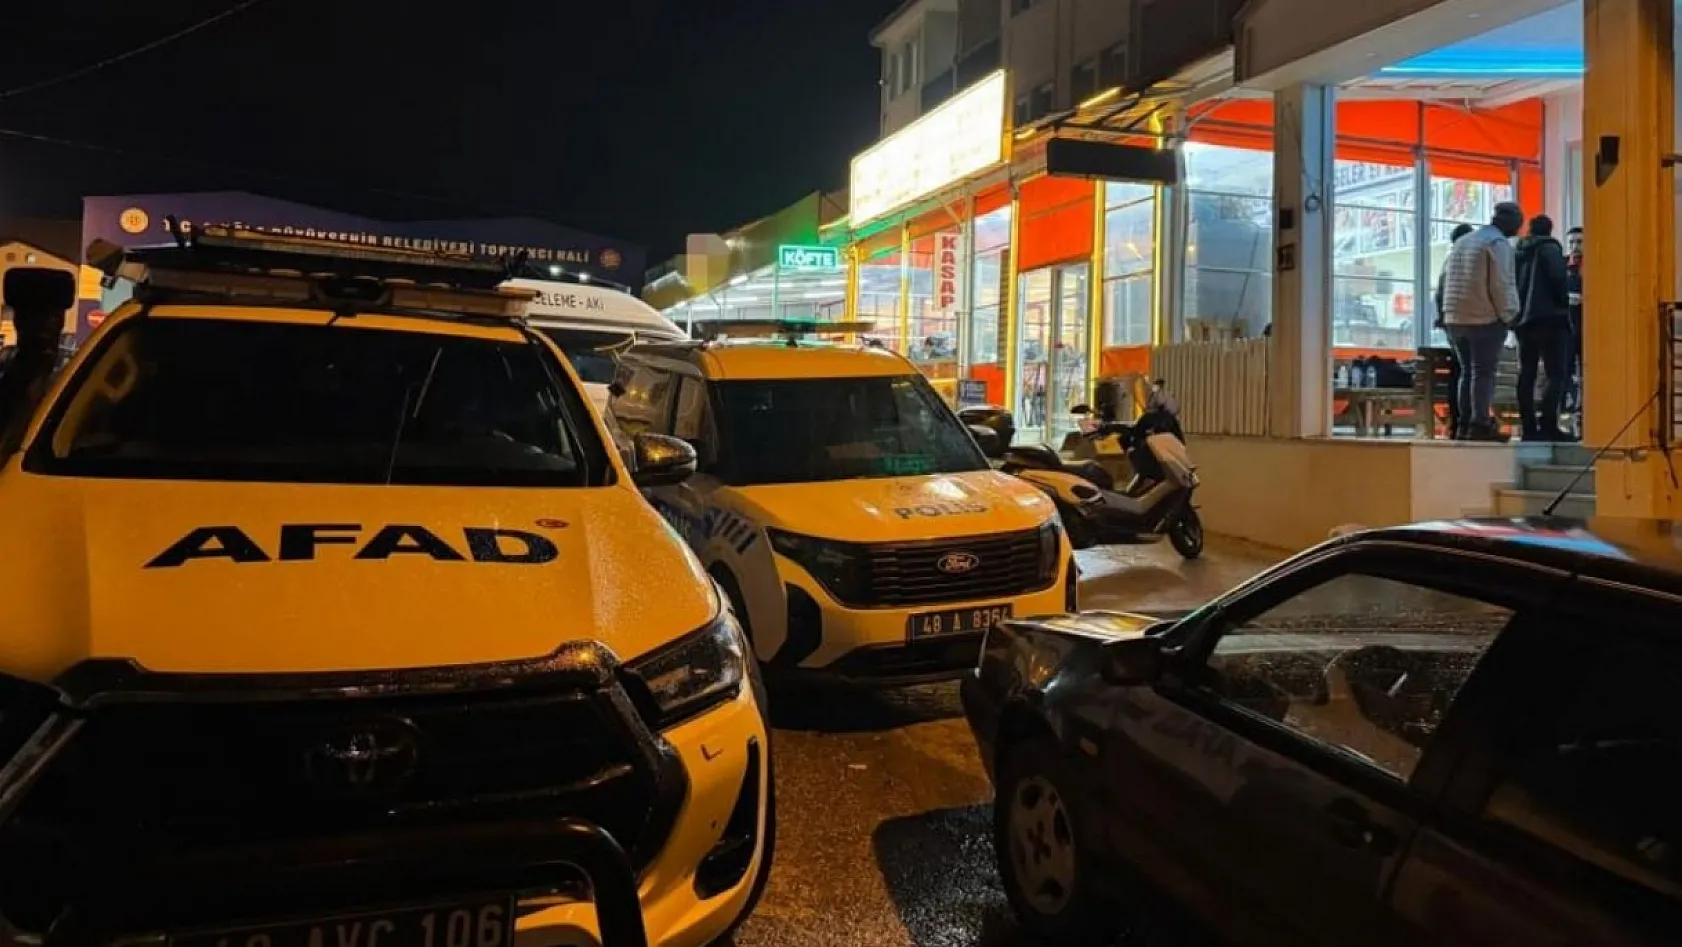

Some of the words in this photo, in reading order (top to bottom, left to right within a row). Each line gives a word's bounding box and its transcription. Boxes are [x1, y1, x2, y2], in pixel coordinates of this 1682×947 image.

[785, 248, 834, 267] KÖFTE
[941, 235, 956, 308] KASAP
[143, 524, 560, 567] AFAD
[923, 614, 942, 633] 48
[953, 612, 961, 632] A
[420, 904, 504, 947] 106
